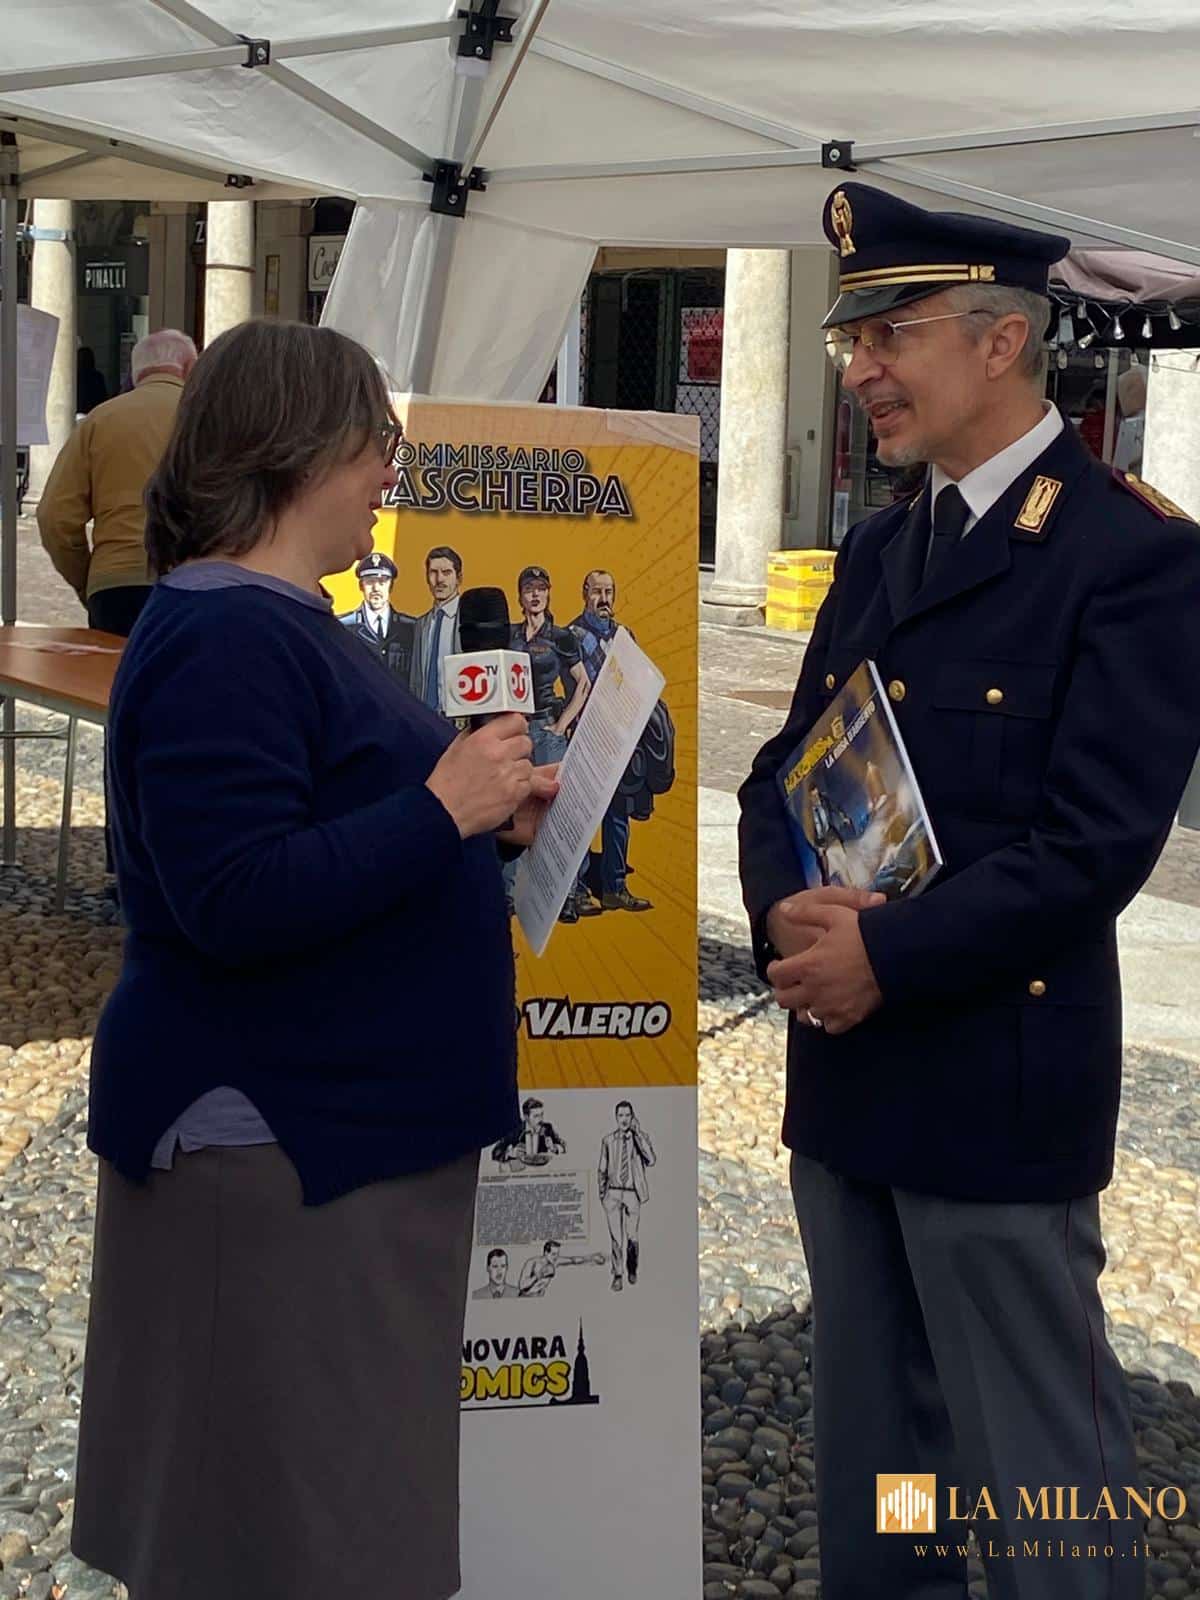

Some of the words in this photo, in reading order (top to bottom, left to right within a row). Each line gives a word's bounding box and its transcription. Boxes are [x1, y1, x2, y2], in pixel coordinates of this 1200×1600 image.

[392, 441, 585, 473] OMMISSARIO
[382, 466, 632, 516] ASCHERPA
[523, 996, 670, 1038] VALERIO
[459, 1360, 571, 1401] OMICS
